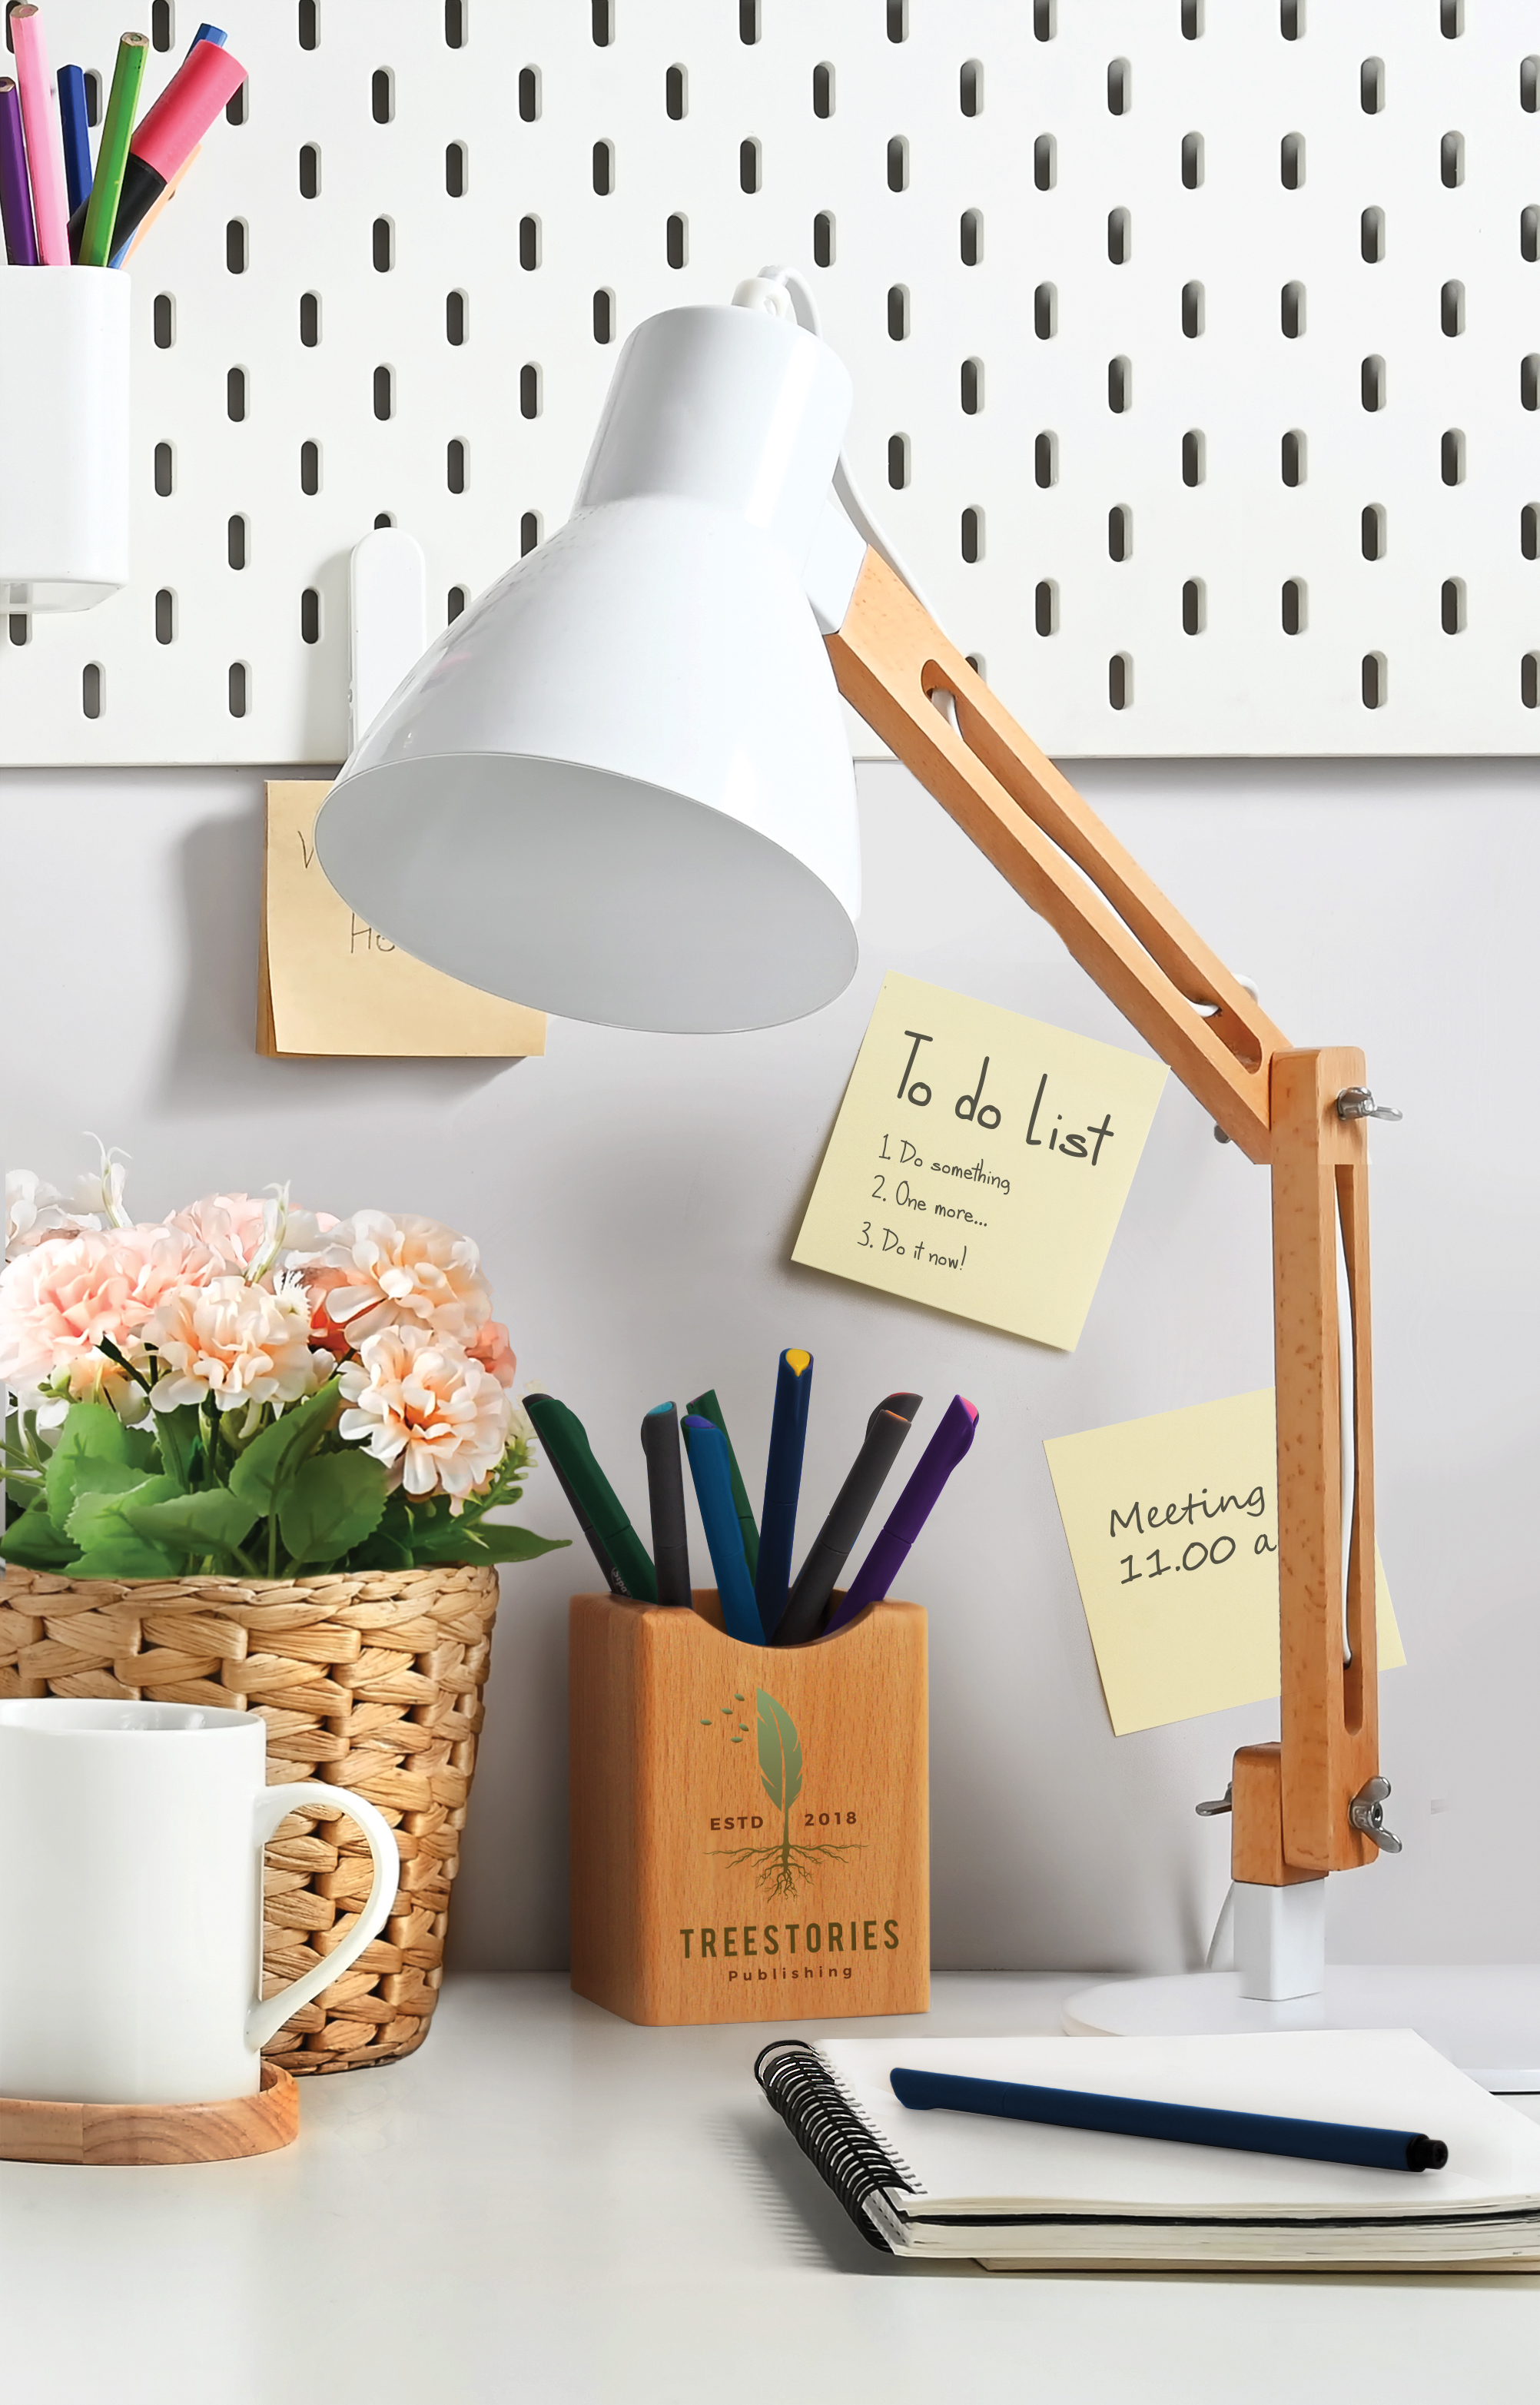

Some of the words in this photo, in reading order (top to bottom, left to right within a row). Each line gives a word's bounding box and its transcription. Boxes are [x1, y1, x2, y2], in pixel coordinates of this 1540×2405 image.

[896, 1029, 934, 1108] To
[954, 1055, 1002, 1131] do
[878, 1132, 892, 1161] 1.
[899, 1138, 924, 1168] Do
[929, 1158, 1011, 1196] something
[871, 1174, 888, 1202] 2.
[894, 1179, 928, 1211] One
[934, 1203, 988, 1227] more...
[856, 1220, 875, 1249] 3.
[881, 1227, 906, 1255] Do
[912, 1240, 926, 1261] it
[928, 1244, 968, 1271] now!
[1109, 1485, 1266, 1538] Meeting
[1119, 1535, 1237, 1586] 11.00
[709, 1815, 765, 1831] ESTD
[804, 1810, 858, 1827] 2018
[679, 1918, 900, 1959] TREESTORIES
[728, 1965, 853, 1982] Publishing
